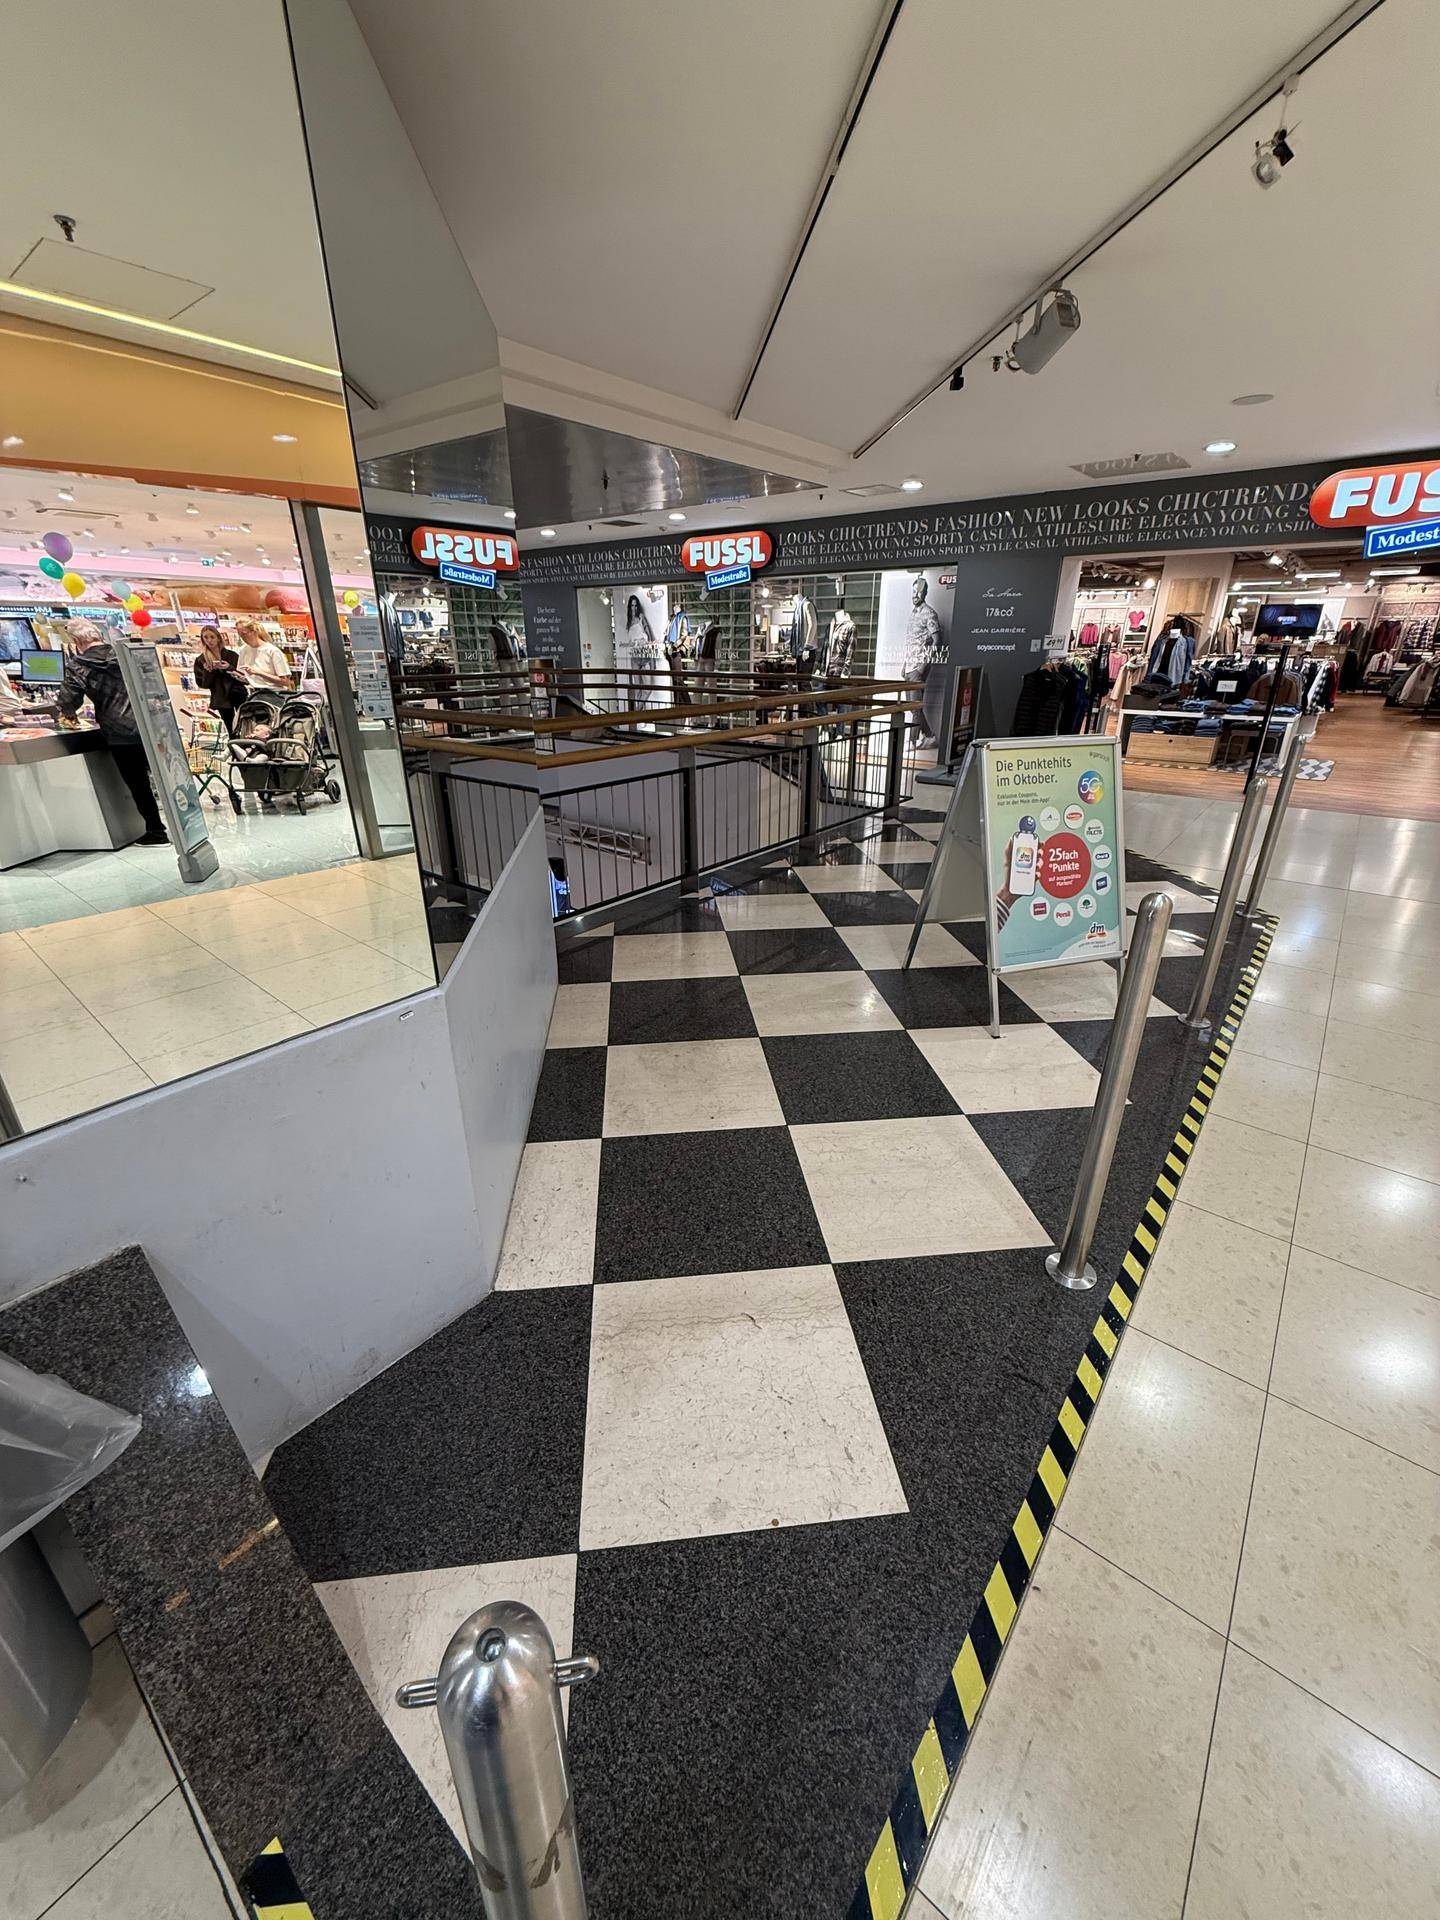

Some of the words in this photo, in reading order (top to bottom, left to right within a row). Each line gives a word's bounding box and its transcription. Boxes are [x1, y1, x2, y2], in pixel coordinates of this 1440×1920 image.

[779, 529, 825, 546] LOOKS
[830, 518, 929, 542] CHICTRENDS
[934, 510, 1016, 532] FASHION
[1022, 504, 1068, 524] NEW
[1073, 497, 1150, 520] LOOKS
[866, 536, 909, 551] YOUNG
[913, 532, 964, 546] SPORTY
[970, 526, 1027, 542] CASUAL
[1033, 517, 1133, 537] ATHLESURE
[1139, 510, 1214, 529] ELEGAN
[1220, 504, 1290, 523] YOUNG
[689, 536, 766, 567] FUSSL
[896, 548, 936, 559] FASHION
[939, 545, 975, 556] SPORTY
[980, 542, 1012, 552] STYLE
[1015, 538, 1058, 550] CASUAL
[1138, 527, 1208, 542] ELEGANCE
[1210, 523, 1260, 537] YOUNG
[588, 550, 621, 563] LOOKS
[996, 760, 1014, 772] Die
[1016, 757, 1072, 771] Punktehits
[996, 775, 1010, 787] im
[1013, 773, 1058, 786] Oktober.
[1090, 922, 1105, 934] dm
